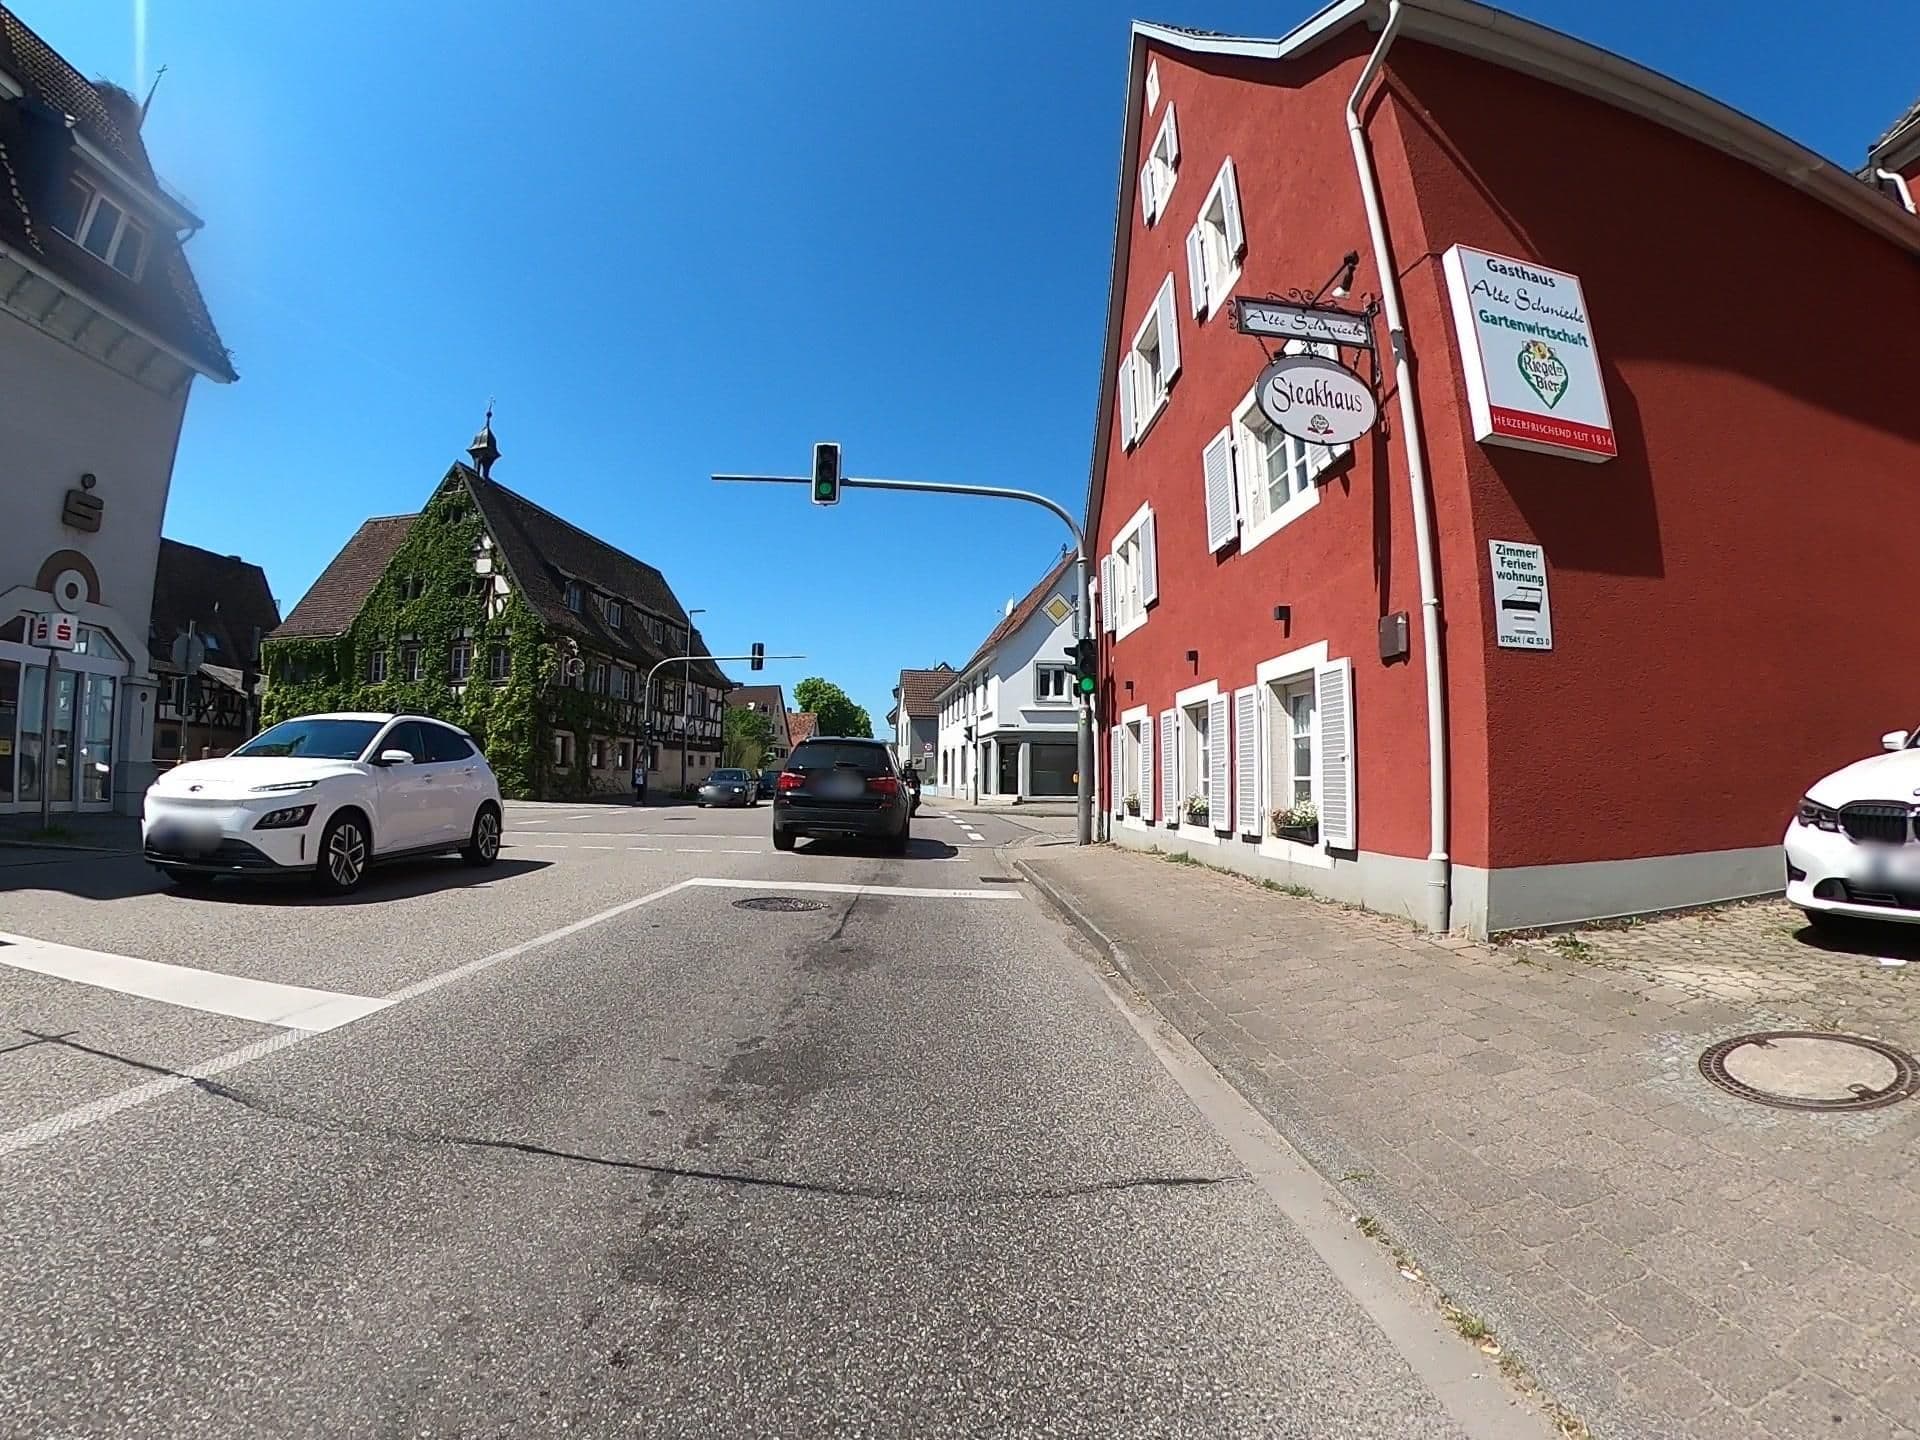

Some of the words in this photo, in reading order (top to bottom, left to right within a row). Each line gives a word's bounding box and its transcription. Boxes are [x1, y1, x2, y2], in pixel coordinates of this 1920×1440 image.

[1486, 258, 1556, 288] Gasthaus
[1470, 279, 1510, 304] Alte
[1514, 287, 1585, 324] Schmiede
[1246, 309, 1286, 327] Alte
[1290, 314, 1366, 338] Schmiede
[1478, 308, 1589, 348] Gartenwirtschaft
[1271, 376, 1363, 413] Steakhaus
[1496, 569, 1545, 587] wohnung
[1500, 556, 1537, 571] Ferien-
